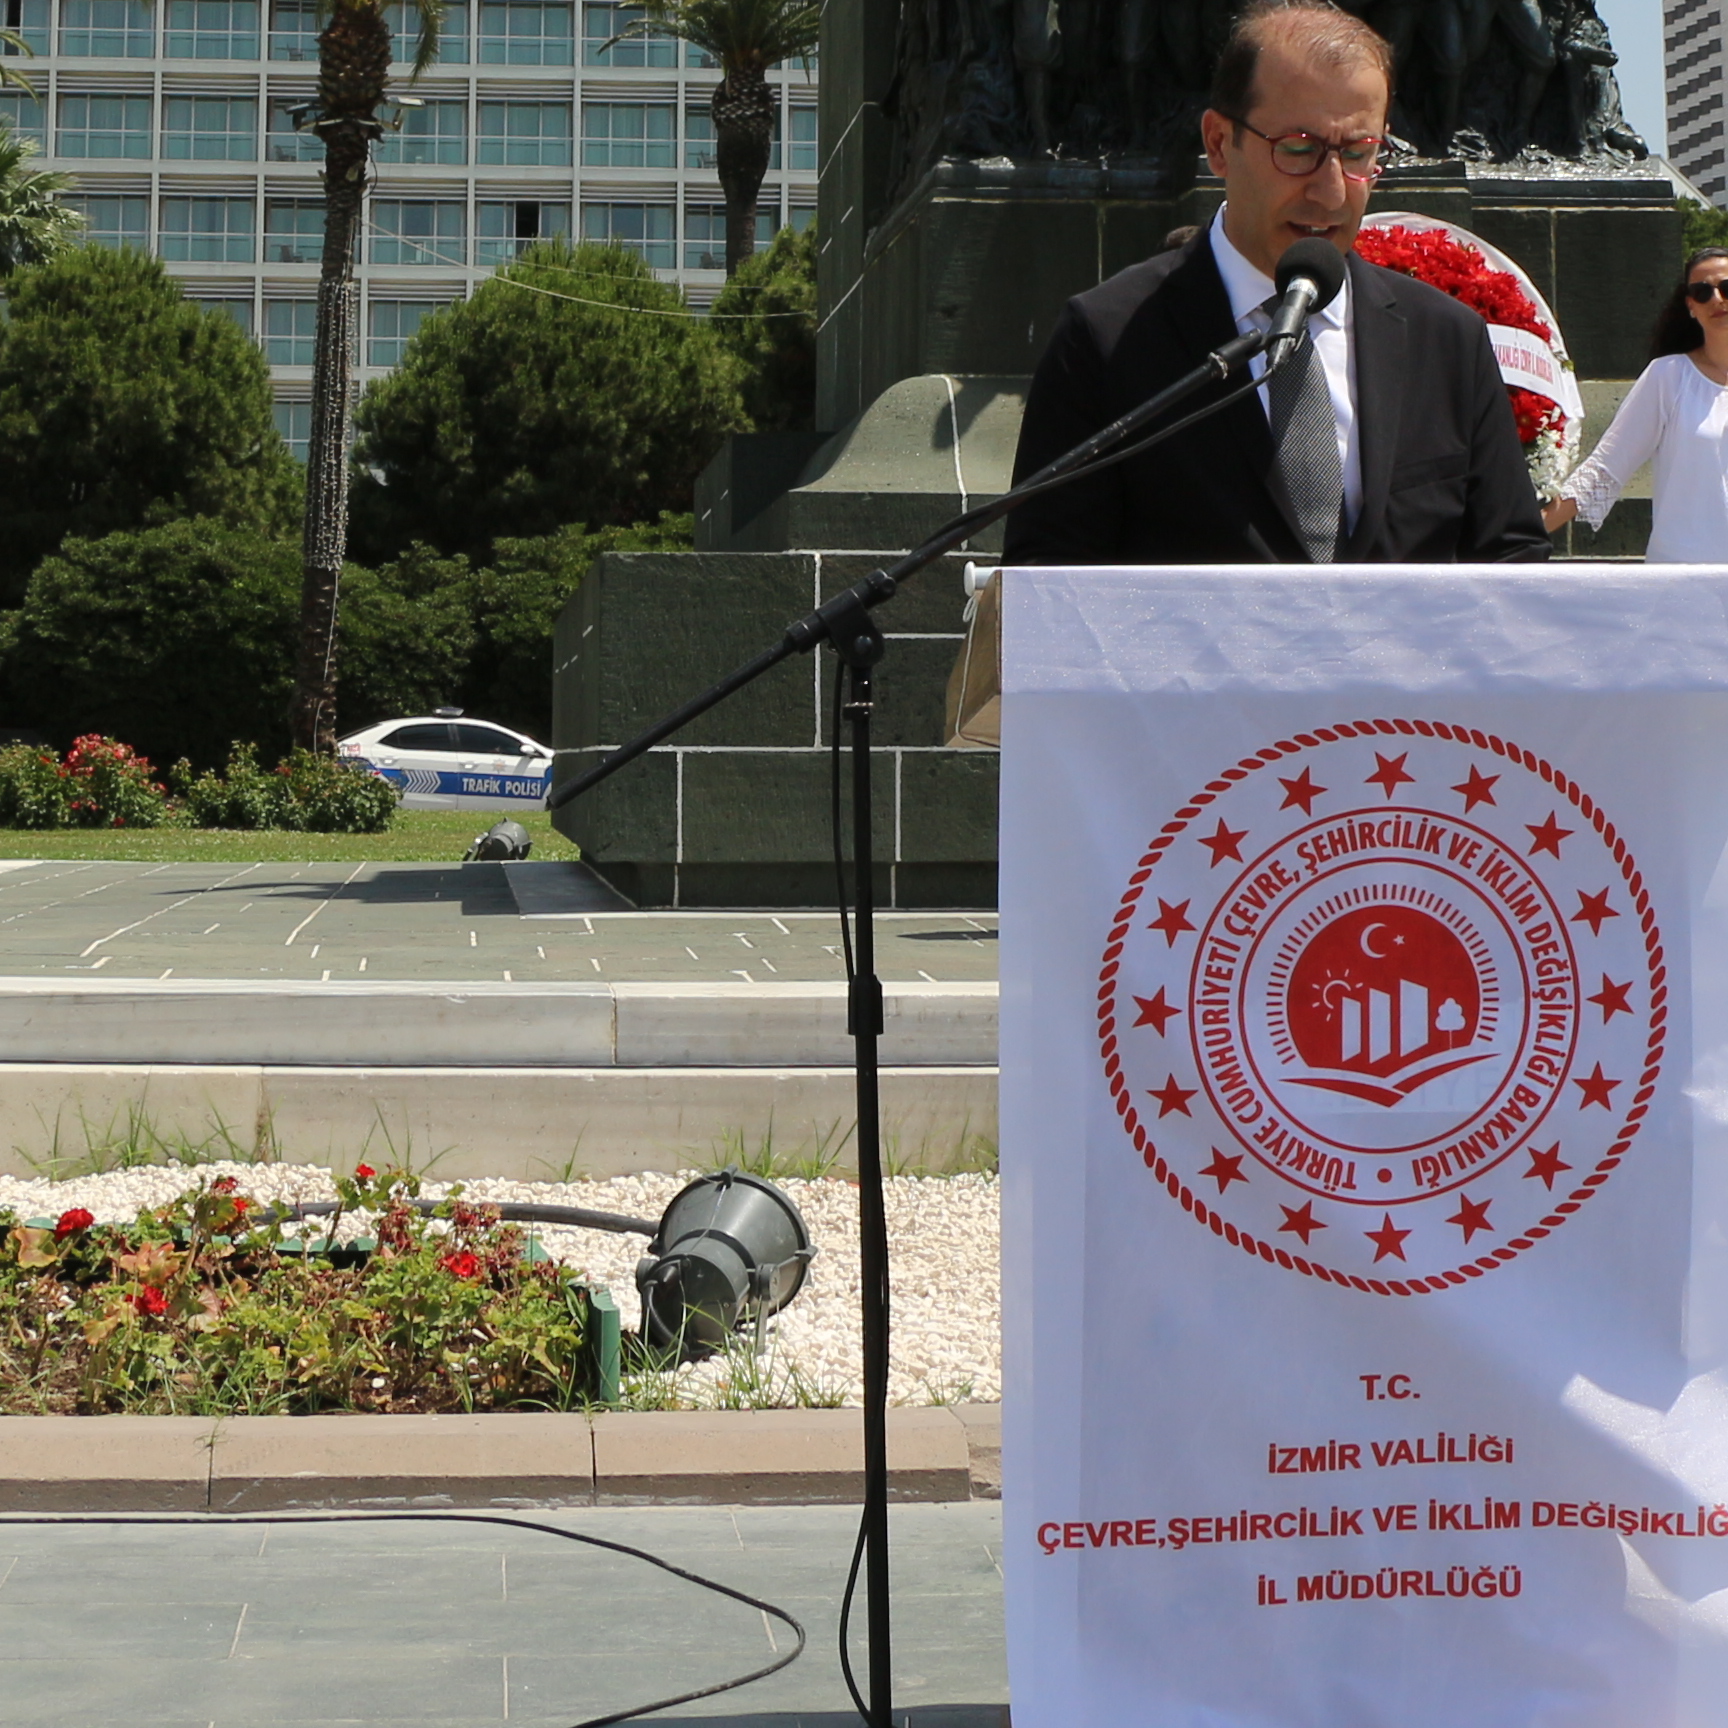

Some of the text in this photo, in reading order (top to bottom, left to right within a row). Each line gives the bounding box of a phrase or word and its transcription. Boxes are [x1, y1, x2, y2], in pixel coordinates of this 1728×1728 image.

[462, 776, 542, 797] TRAFİK POLİSİ
[1297, 813, 1448, 878] ŞEHİRCİLİK
[1447, 832, 1483, 869] VE
[1223, 860, 1302, 939] ÇEVRE,
[1475, 847, 1542, 925] İKLİM
[1195, 934, 1265, 1125] CUMHURİYETİ
[1524, 920, 1574, 1090] DEĞİŞİKLİĞİ
[1252, 1117, 1358, 1193] TÜRKİYE
[1411, 1083, 1542, 1189] BAKANLIĞI
[1359, 1373, 1422, 1402] T.C.
[1267, 1432, 1514, 1475] İZMİR VALİLİĞİ
[1036, 1506, 1365, 1557] ÇEVRE,ŞEHİRCİLİK
[1373, 1503, 1418, 1533] VE
[1427, 1495, 1521, 1532] İKLİM
[1257, 1565, 1523, 1606] İL MÜDÜRLÜĞÜ
